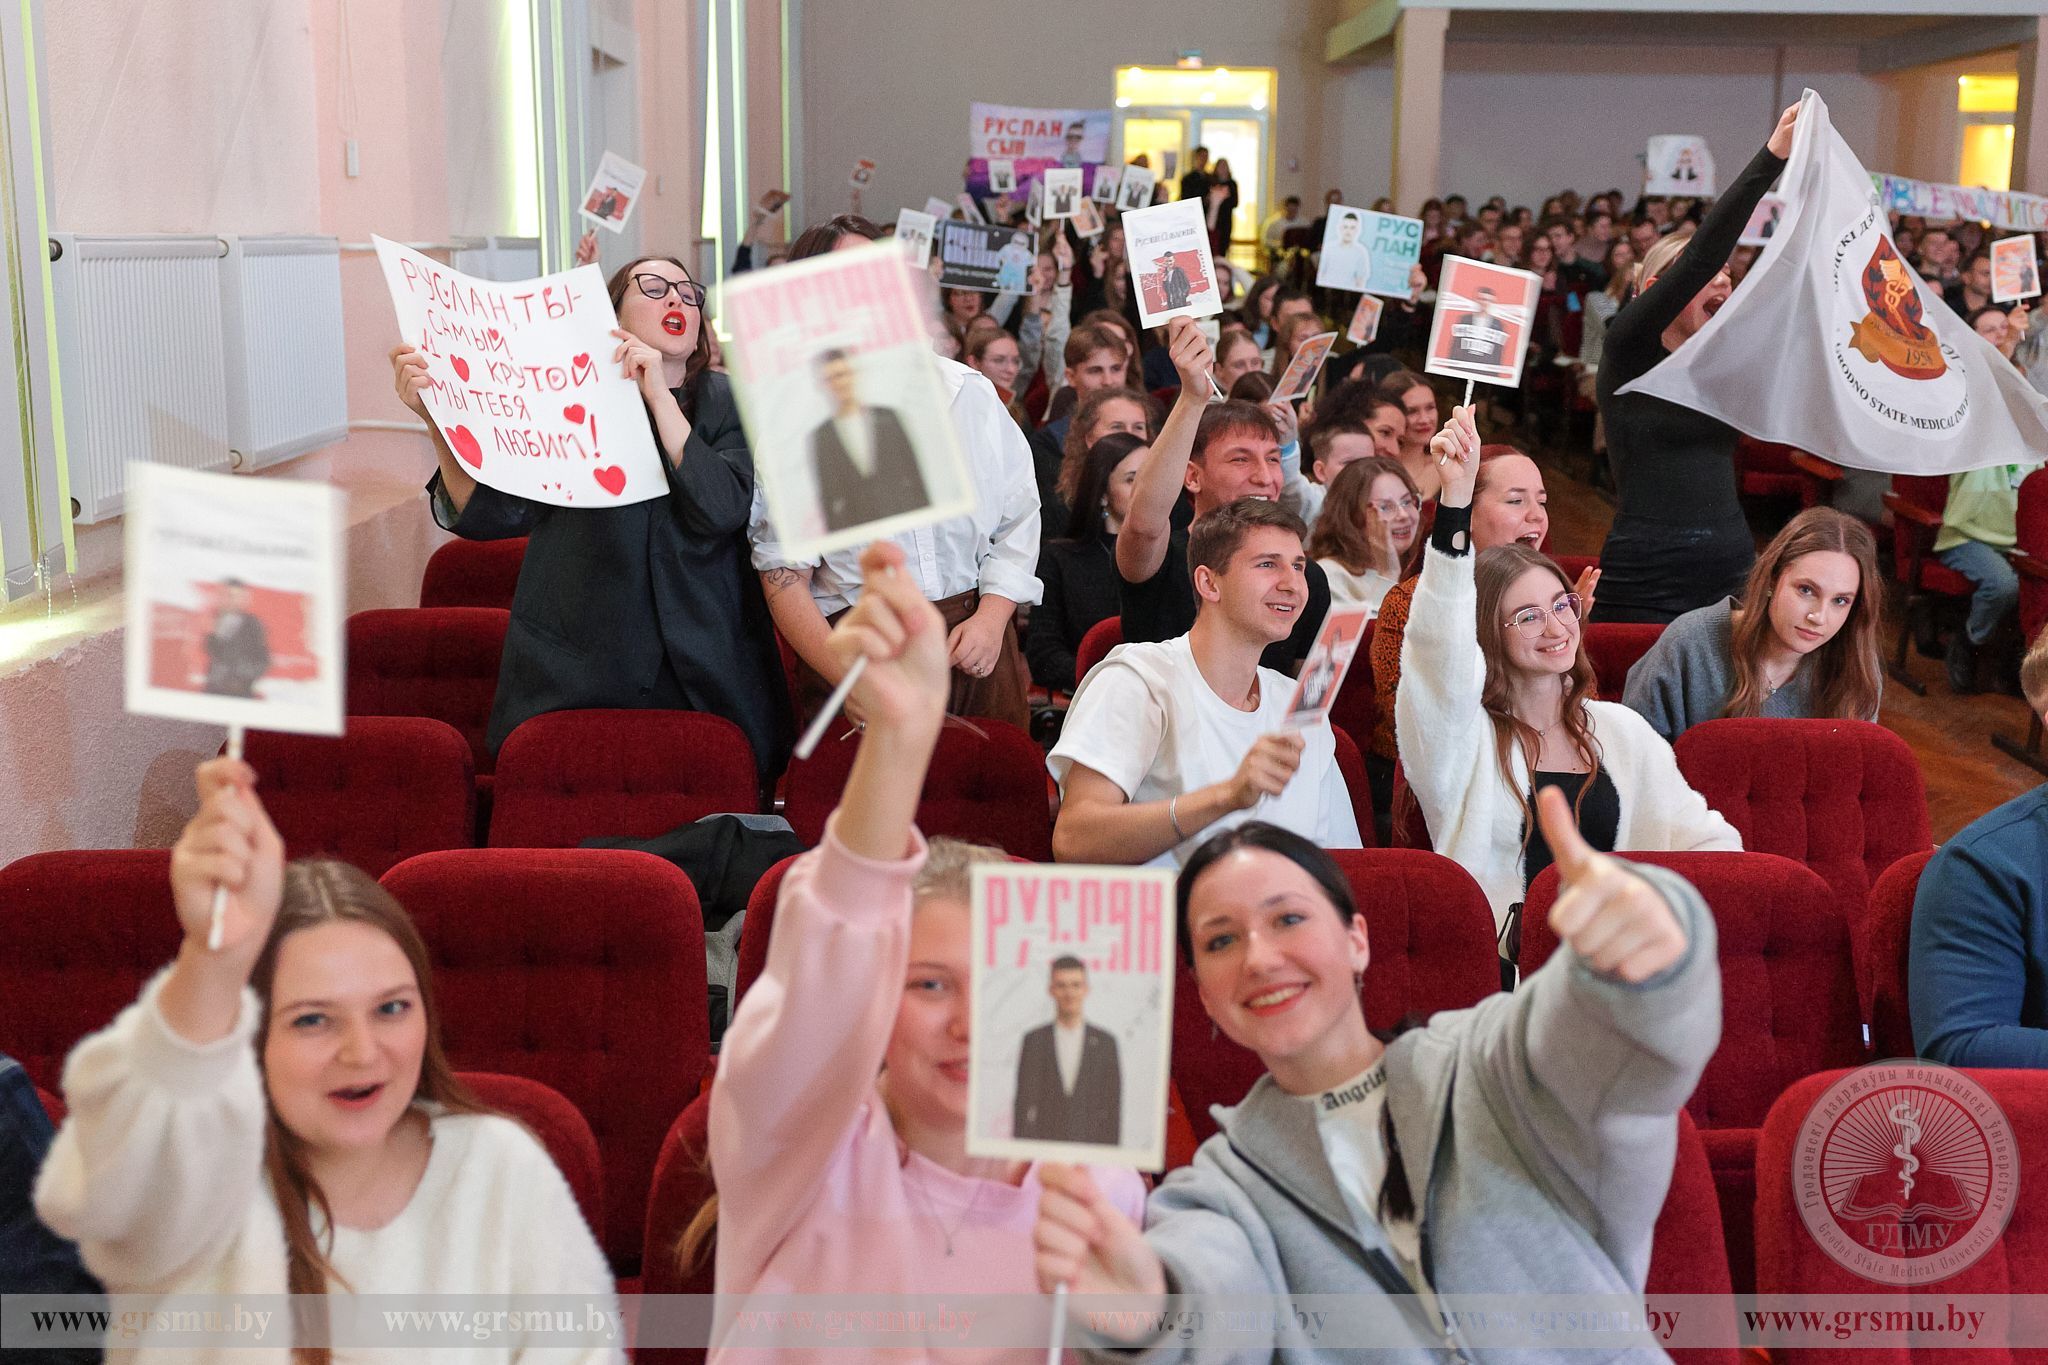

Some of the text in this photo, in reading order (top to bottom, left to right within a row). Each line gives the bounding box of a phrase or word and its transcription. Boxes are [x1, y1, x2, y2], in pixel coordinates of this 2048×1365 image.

[1378, 216, 1419, 238] РУС
[431, 376, 532, 421] МЫ ТЕБЯ
[1869, 396, 1908, 425] STATE
